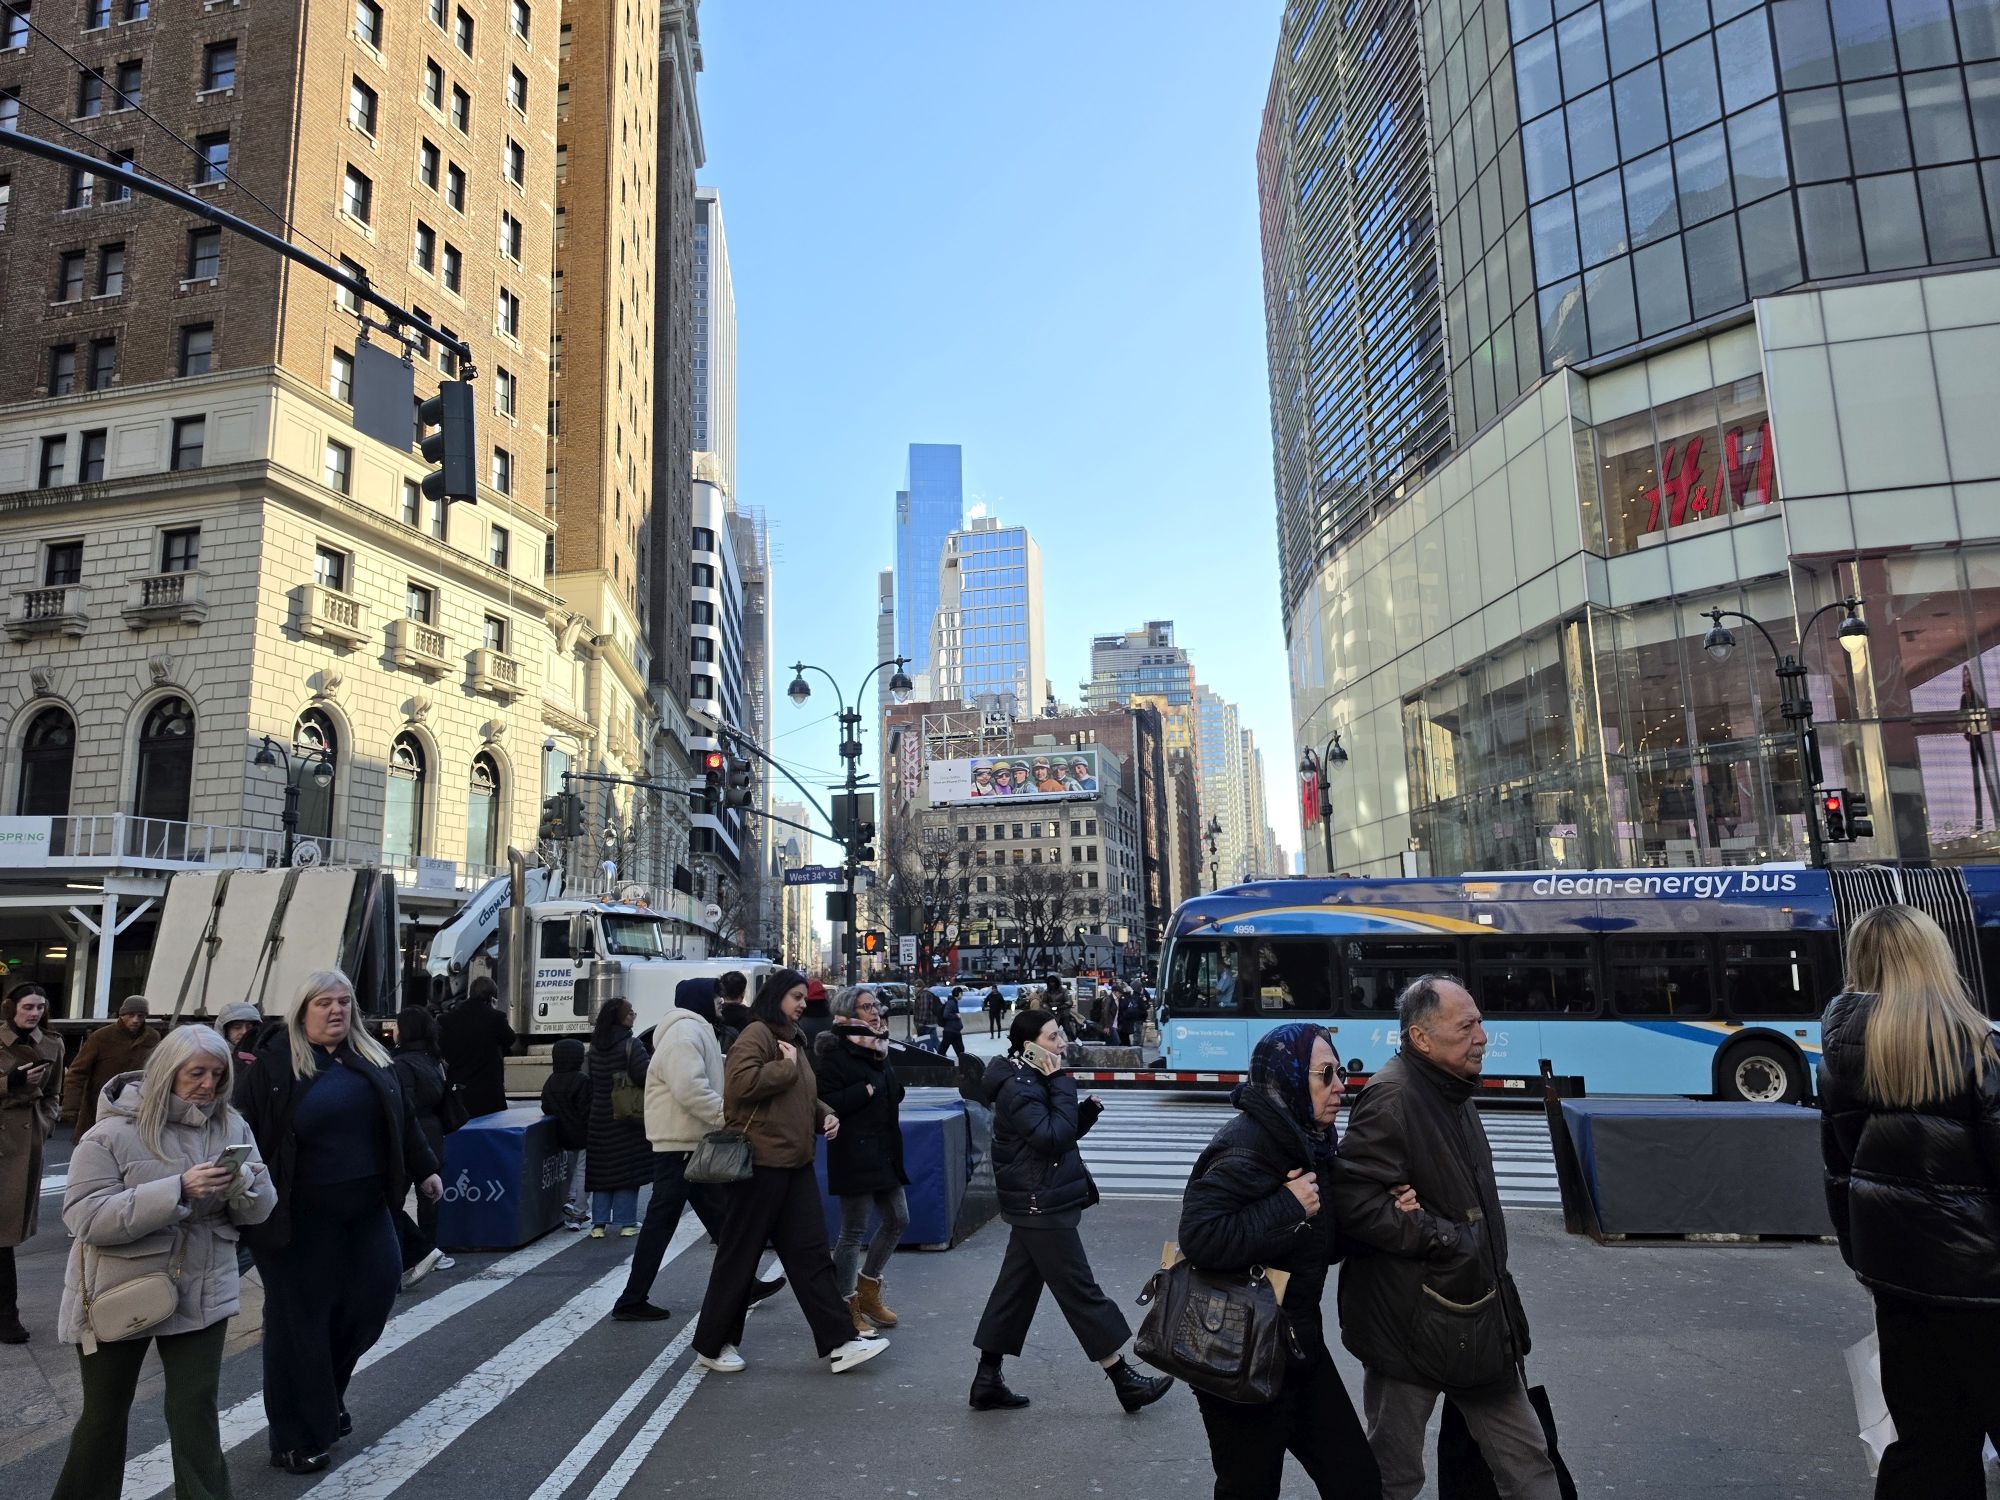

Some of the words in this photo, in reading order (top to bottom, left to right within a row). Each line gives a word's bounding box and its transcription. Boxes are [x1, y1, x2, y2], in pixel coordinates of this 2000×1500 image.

[1641, 418, 1773, 533] H&M
[789, 873, 810, 882] West
[812, 872, 826, 880] 34th
[828, 872, 837, 880] St
[1532, 874, 1732, 899] clean-energy
[1741, 871, 1796, 892] bus
[1233, 925, 1255, 934] 4959
[902, 953, 914, 962] 15
[538, 969, 571, 977] STONE
[1486, 1032, 1509, 1046] US
